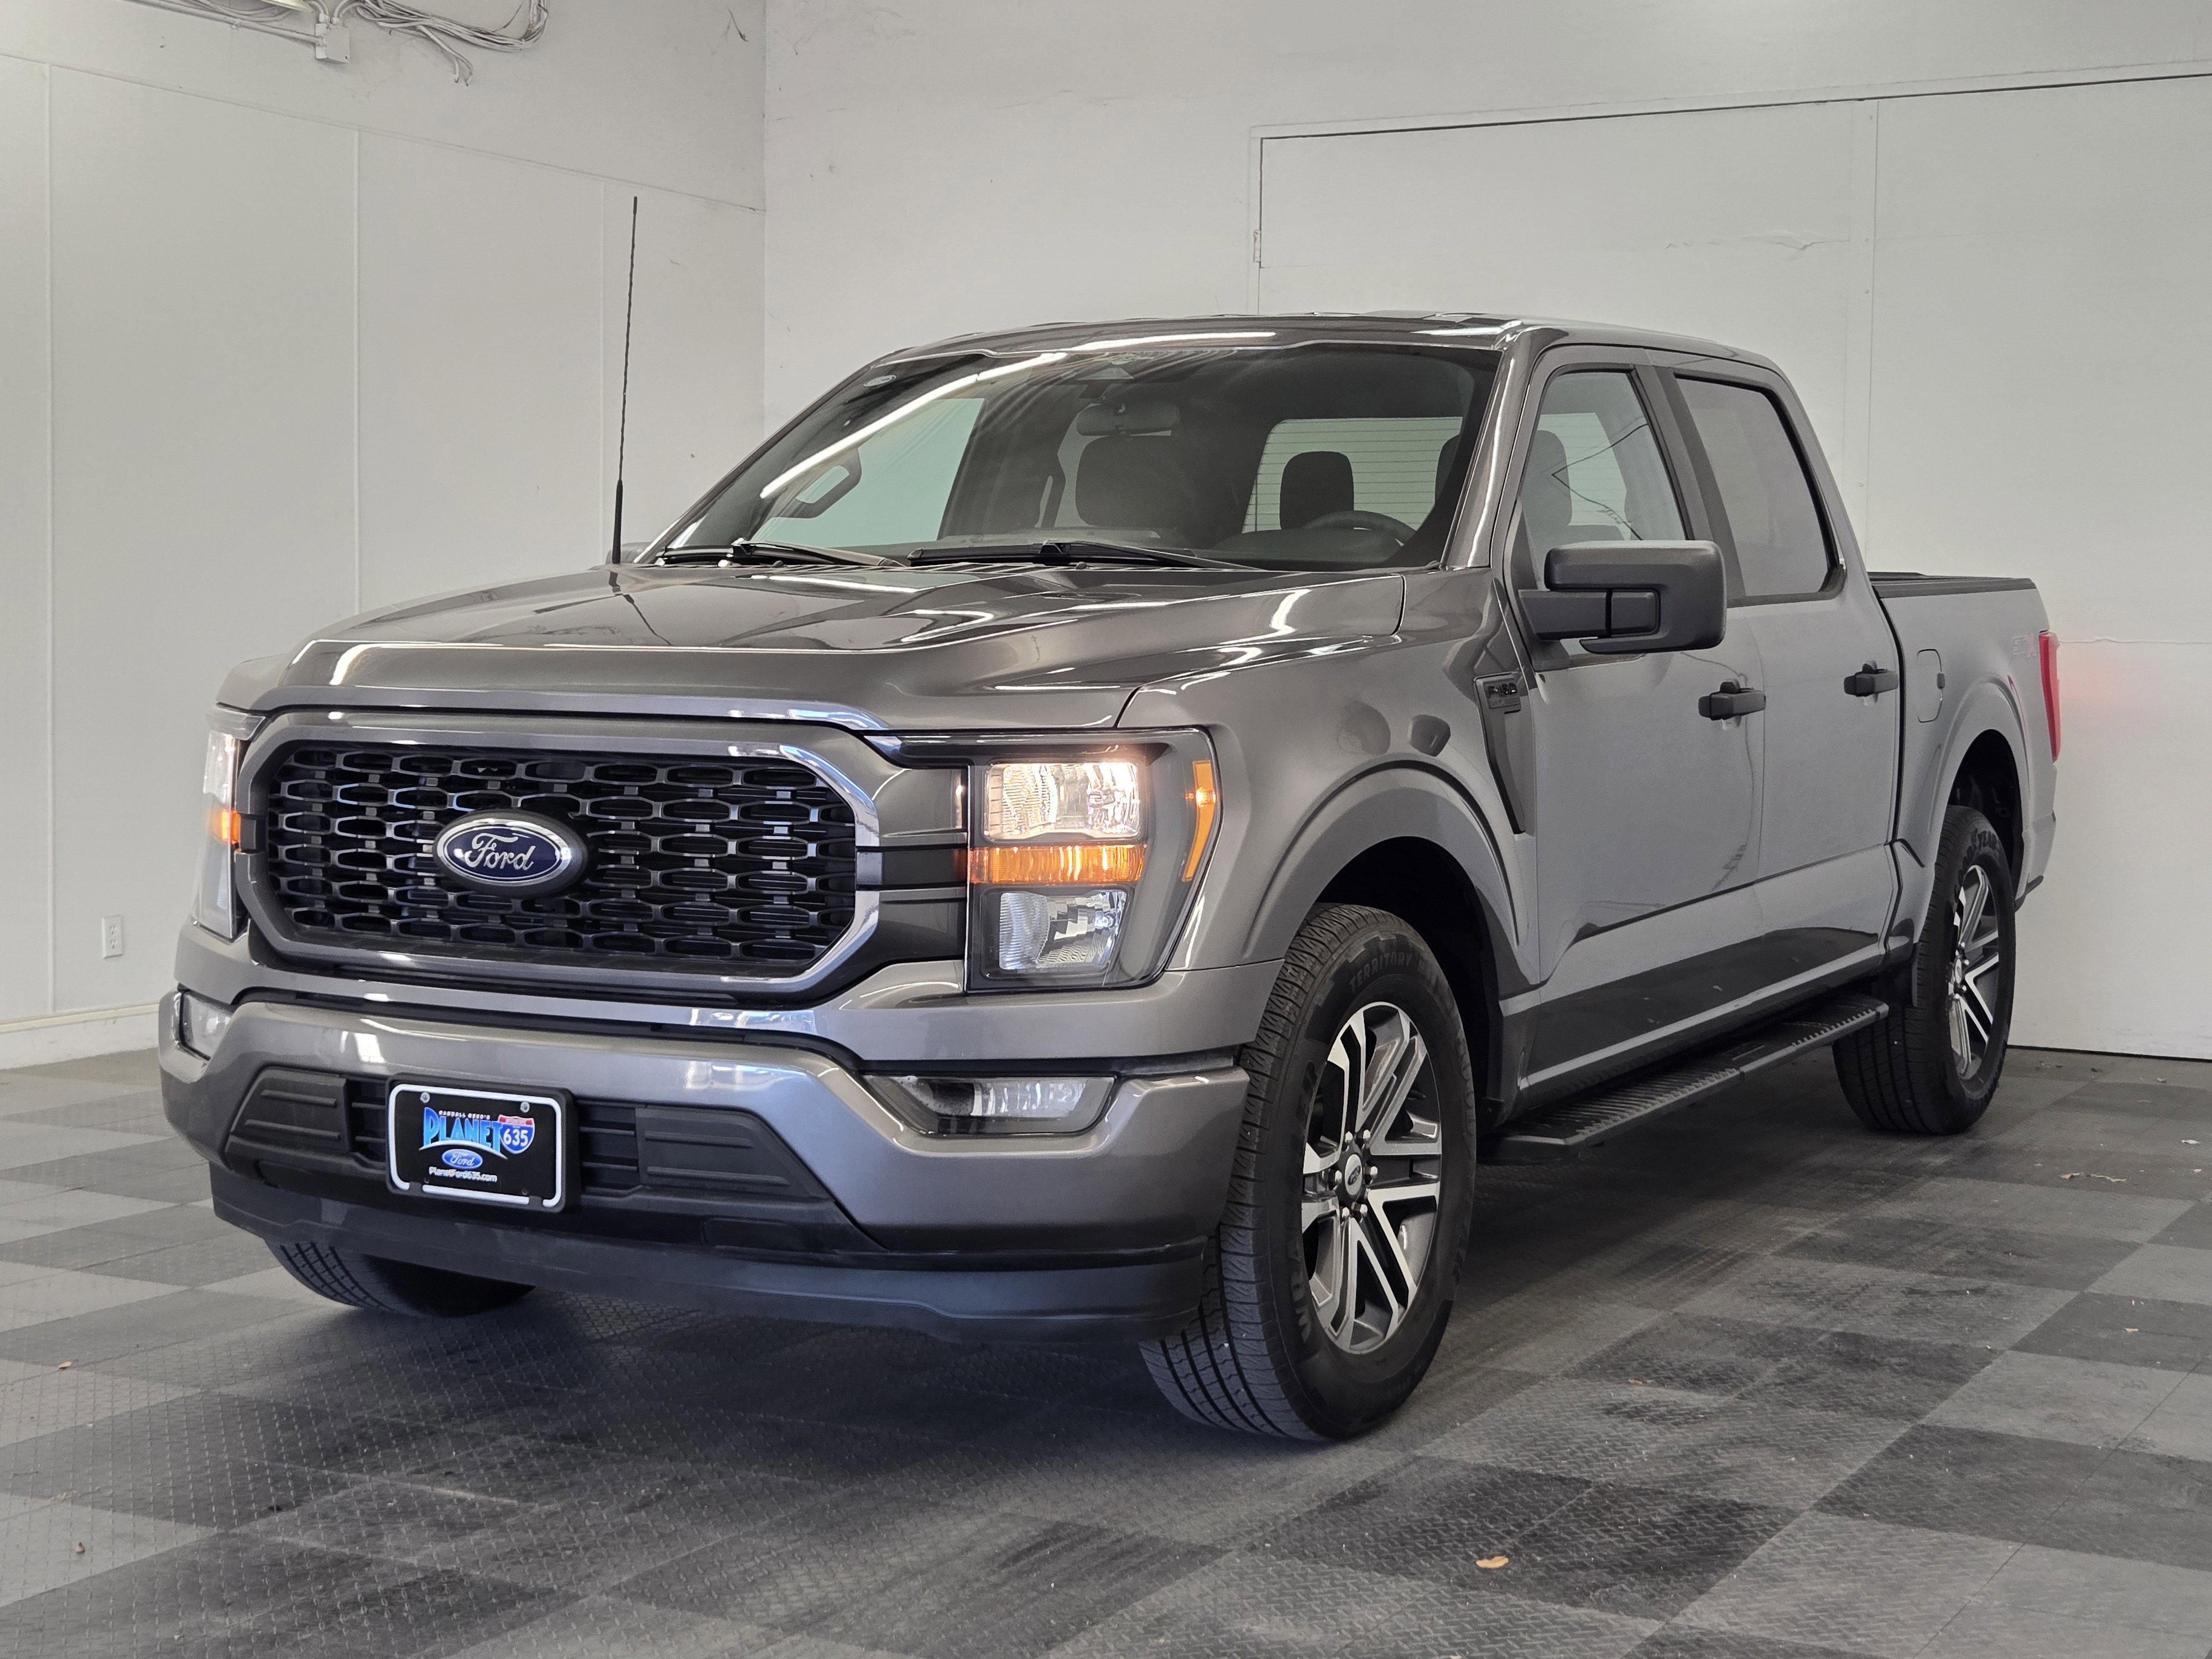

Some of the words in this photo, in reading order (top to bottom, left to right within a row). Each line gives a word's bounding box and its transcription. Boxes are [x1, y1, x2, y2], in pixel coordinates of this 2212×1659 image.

[464, 832, 536, 870] Ford
[1349, 951, 1413, 994] TERRITORY
[423, 1107, 503, 1154] PLANET
[503, 1128, 529, 1147] 635
[450, 1151, 476, 1166] Ford
